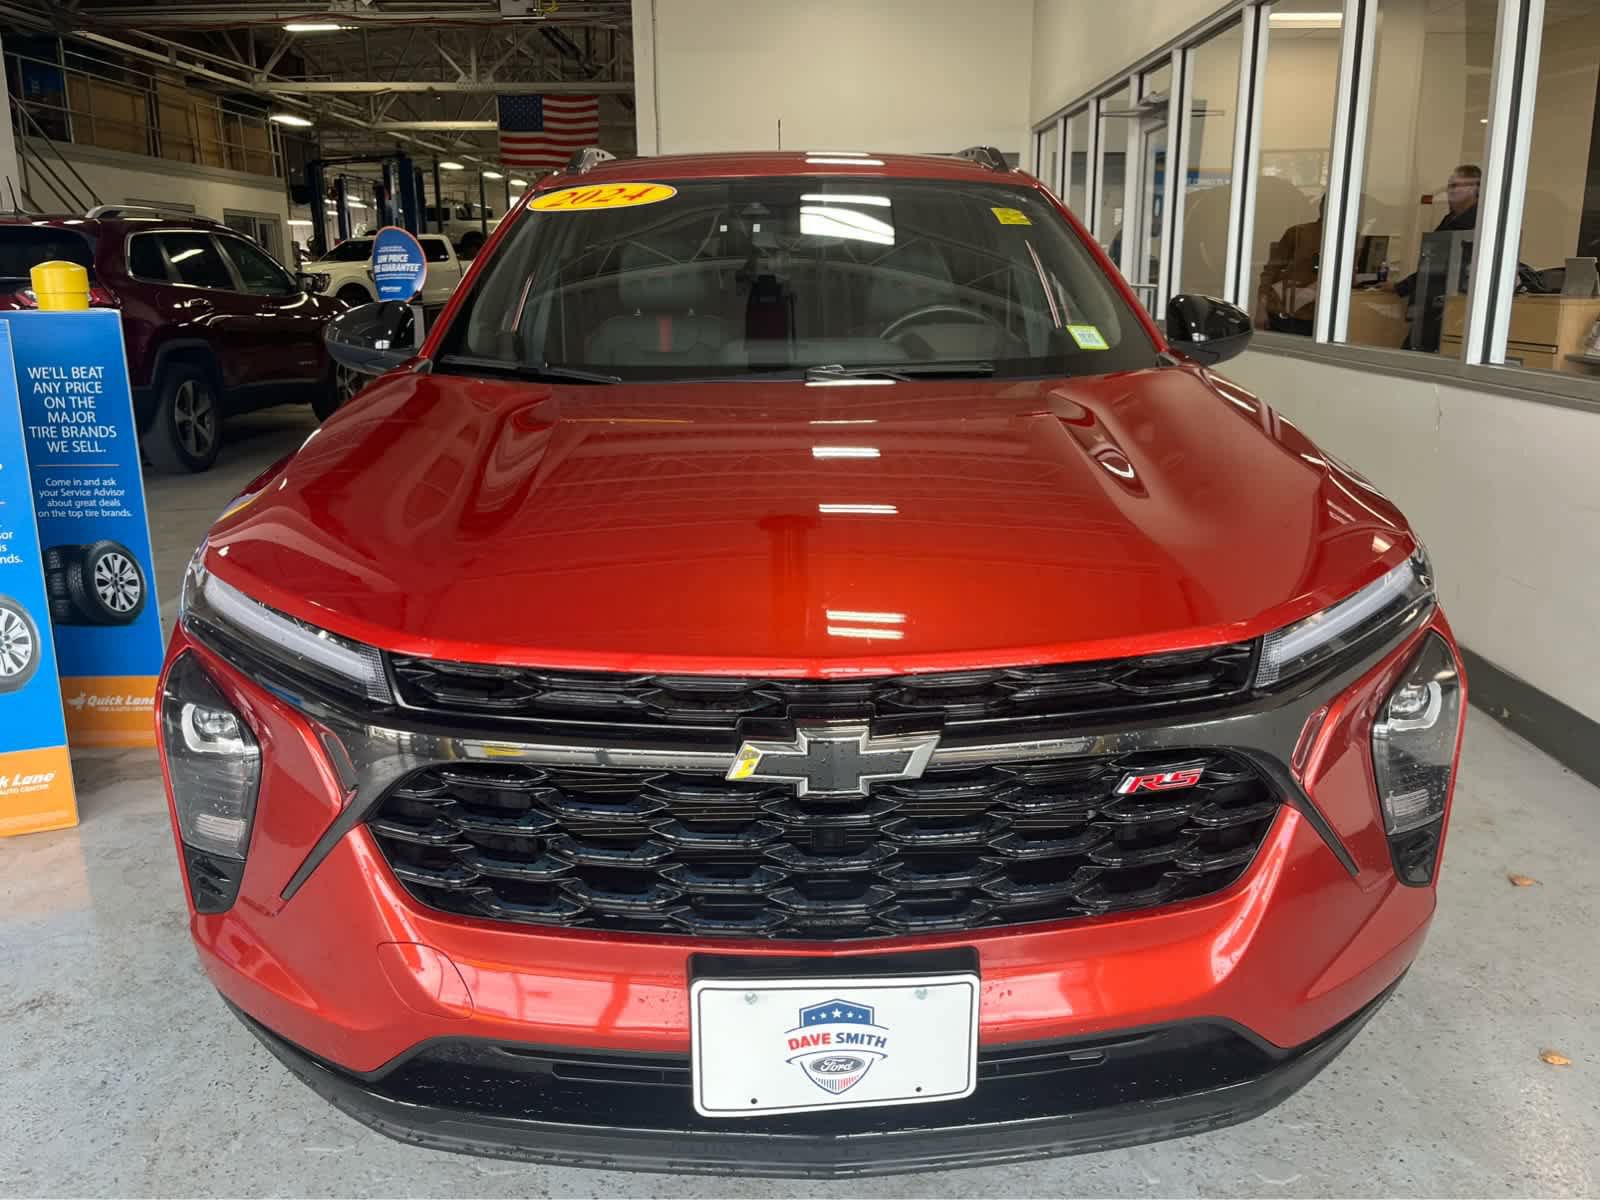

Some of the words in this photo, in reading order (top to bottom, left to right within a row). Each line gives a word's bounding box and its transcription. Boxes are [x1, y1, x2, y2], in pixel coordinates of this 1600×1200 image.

[544, 186, 656, 209] 2024
[27, 367, 68, 380] WE'LL
[71, 366, 104, 379] BEAT
[33, 382, 61, 395] ANY
[65, 381, 103, 394] PRICE
[43, 396, 66, 409] ON
[69, 396, 96, 409] THE
[47, 411, 96, 424] MAJOR
[29, 426, 58, 439] TIRE
[61, 425, 118, 438] BRANDS
[47, 441, 69, 453] WE
[73, 440, 107, 453] SELL.
[45, 477, 72, 487] Come
[73, 477, 82, 486] in
[83, 477, 101, 486] and
[102, 477, 117, 486] ask
[39, 489, 59, 498] your
[60, 487, 91, 497] Service
[93, 487, 125, 497] Advisor
[47, 499, 73, 507] about
[74, 499, 97, 509] great
[98, 497, 121, 507] deals
[51, 509, 66, 517] the
[68, 509, 84, 519] top
[84, 509, 100, 518] tire
[101, 507, 133, 518] brands.
[87, 695, 122, 708] Quick
[12, 771, 56, 787] Lane
[1117, 768, 1204, 795] RS
[787, 1032, 832, 1051] DAVE
[835, 1032, 888, 1048] SMITH
[819, 1059, 854, 1072] Ford
